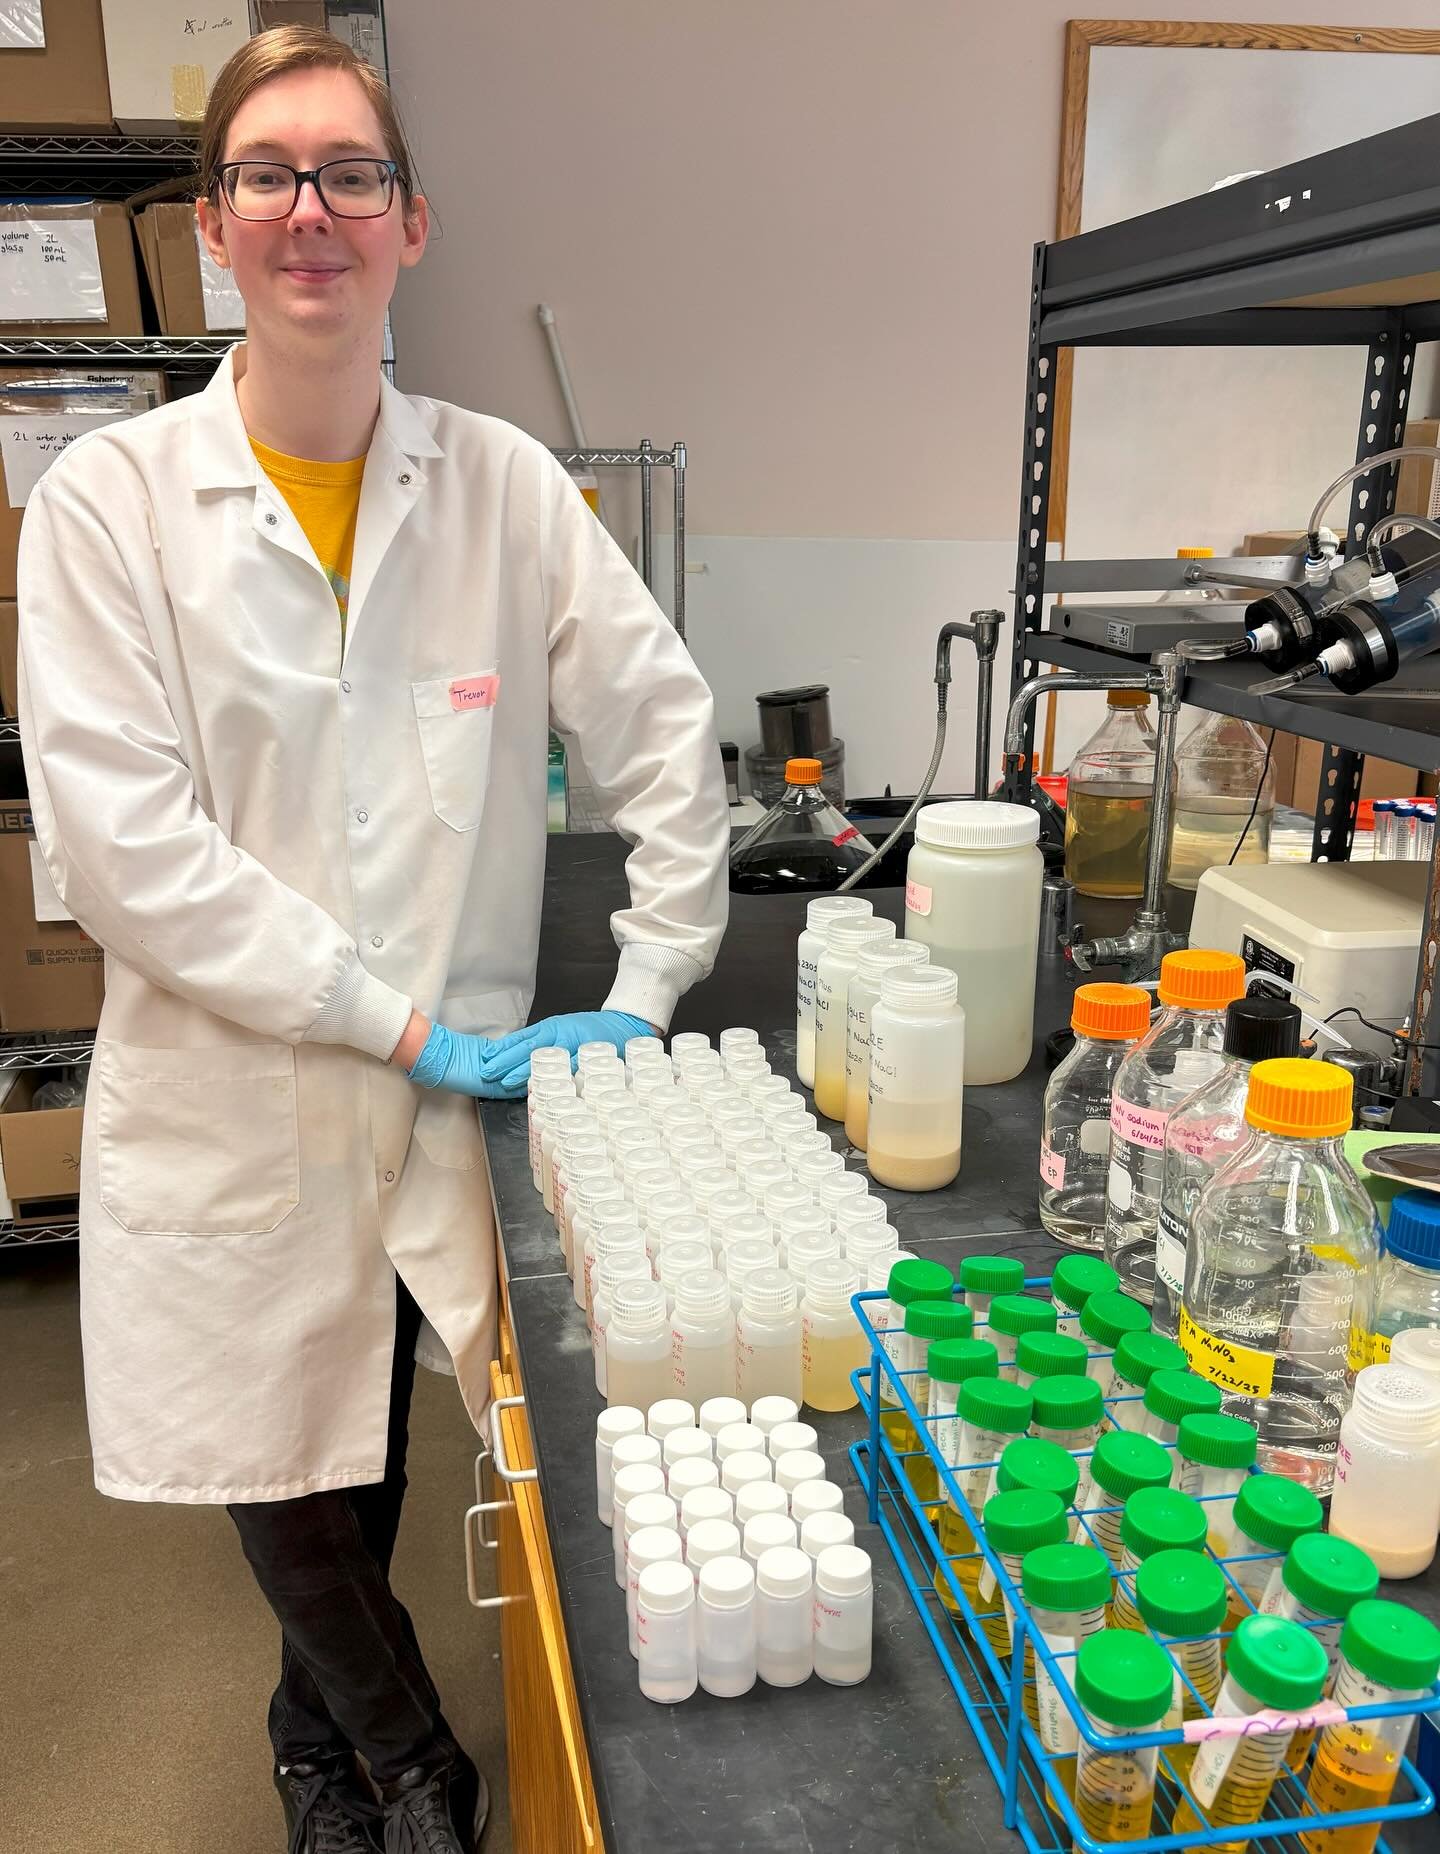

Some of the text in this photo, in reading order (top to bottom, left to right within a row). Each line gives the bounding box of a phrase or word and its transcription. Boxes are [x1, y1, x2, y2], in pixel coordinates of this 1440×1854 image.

[2, 231, 30, 241] volume
[453, 688, 486, 703] Trevor
[1127, 1113, 1160, 1131] sodium
[1334, 1294, 1353, 1305] 800
[1331, 1319, 1350, 1331] 700
[1328, 1344, 1348, 1356] 600
[1208, 1366, 1261, 1395] 7/22/25
[1326, 1369, 1345, 1380] 500
[1323, 1394, 1342, 1405] 400
[1320, 1417, 1340, 1429] 300
[1317, 1441, 1337, 1452] 200
[1361, 1685, 1376, 1697] 45
[1351, 1723, 1364, 1736] 35
[1344, 1743, 1359, 1756] 30
[1339, 1762, 1353, 1776] 25
[1119, 1784, 1133, 1793] 30
[1333, 1783, 1347, 1796] 20
[1117, 1820, 1130, 1830] 20
